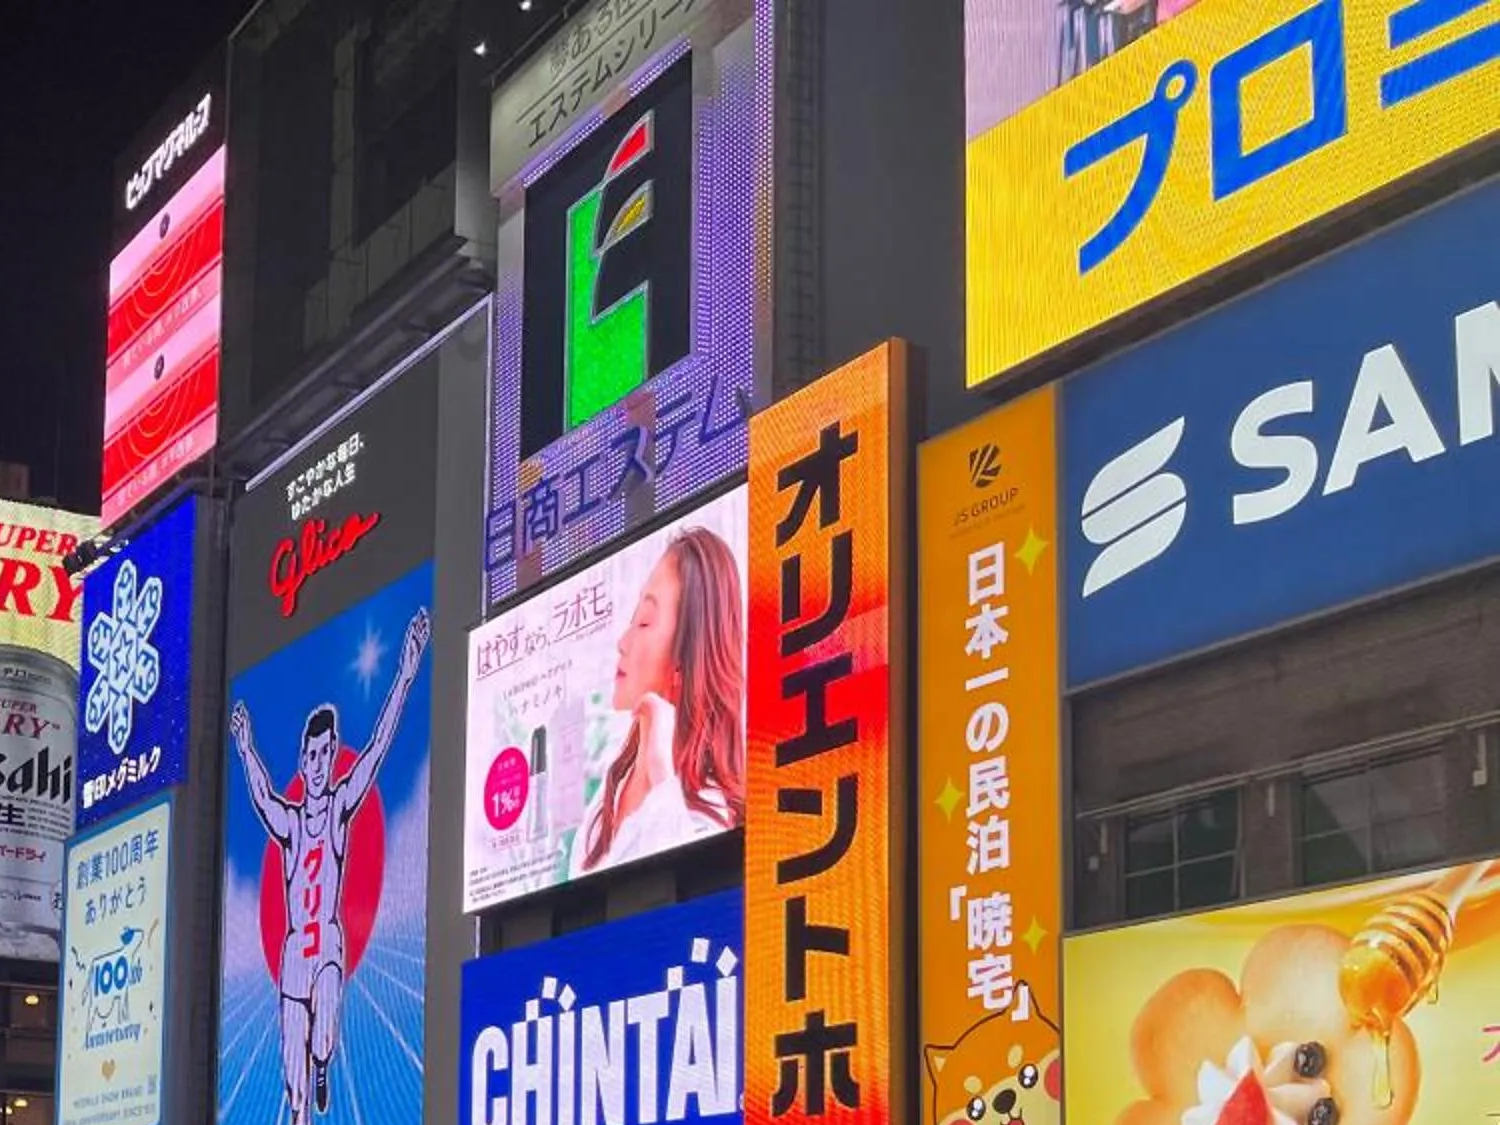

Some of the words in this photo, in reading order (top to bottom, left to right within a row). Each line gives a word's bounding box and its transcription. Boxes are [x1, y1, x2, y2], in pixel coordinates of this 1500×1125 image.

[484, 375, 752, 573] 日商エステム
[971, 487, 1020, 518] GROUP
[269, 512, 381, 618] Glico
[76, 829, 159, 890] 創業100周年
[84, 876, 148, 925] ありがとう
[303, 839, 323, 958] グリコ
